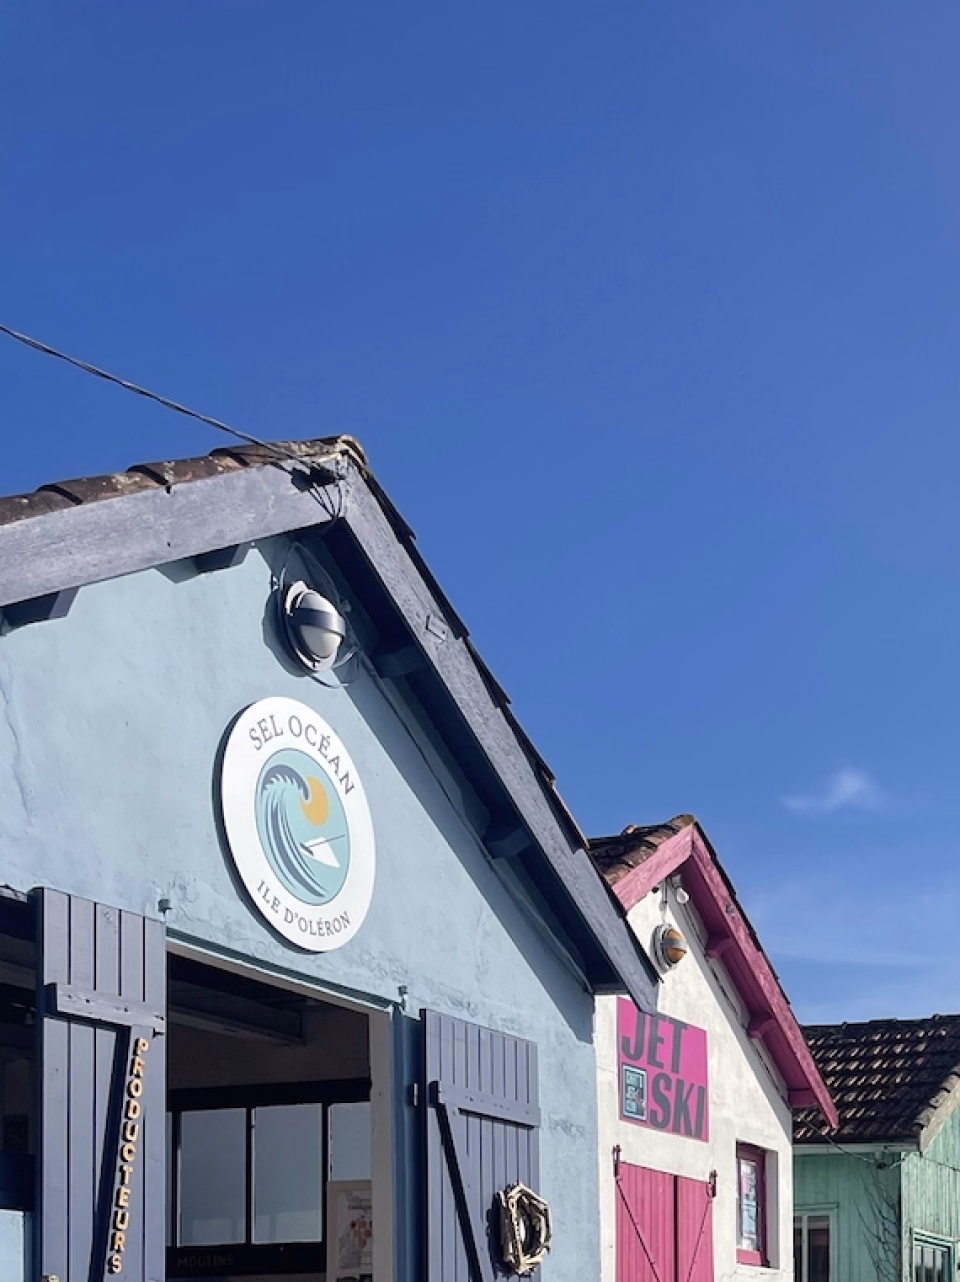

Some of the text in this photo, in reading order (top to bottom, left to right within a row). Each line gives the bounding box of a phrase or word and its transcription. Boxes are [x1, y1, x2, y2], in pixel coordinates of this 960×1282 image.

[248, 714, 355, 796] SEL OCÉAN
[257, 880, 352, 937] ILE D'OLÉRON
[621, 1012, 688, 1075] JET
[649, 1072, 706, 1140] SKI
[109, 1036, 149, 1274] PRODUCTEURS
